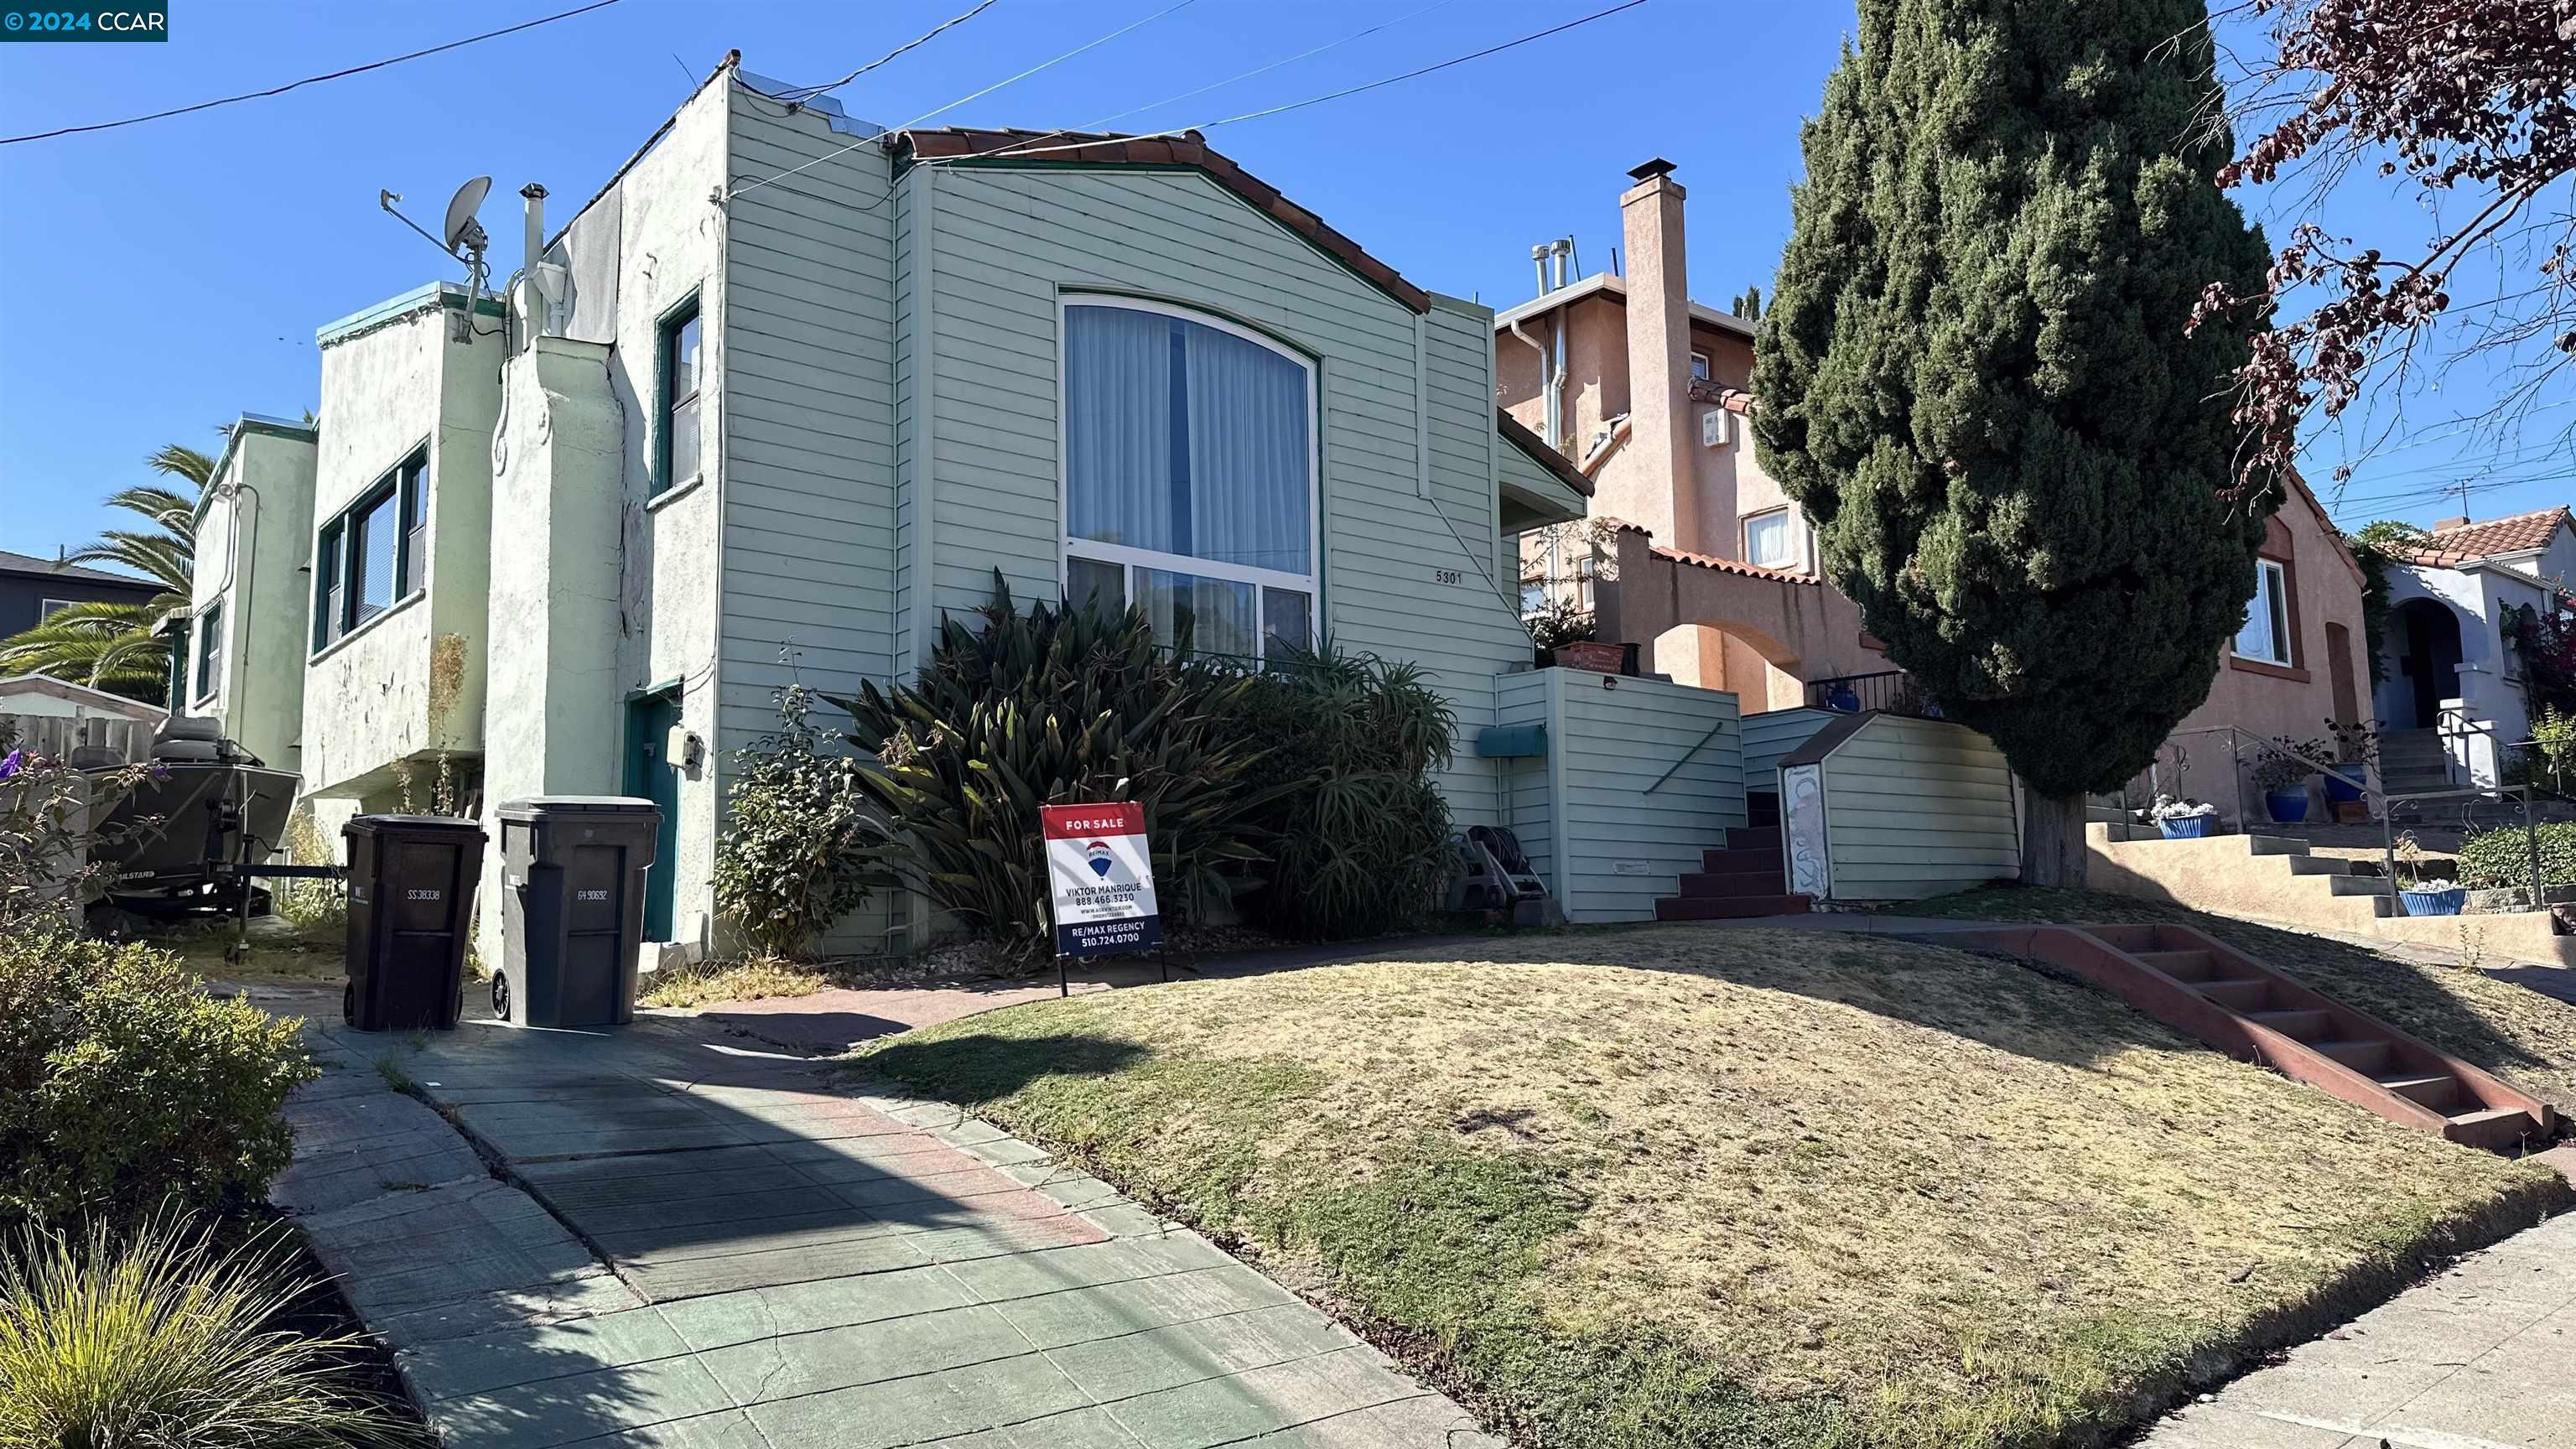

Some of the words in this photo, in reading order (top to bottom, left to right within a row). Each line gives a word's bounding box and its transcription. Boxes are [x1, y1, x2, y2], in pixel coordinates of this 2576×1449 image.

[1436, 570, 1462, 584] 5301
[1066, 820, 1090, 831] FOR
[1093, 818, 1124, 828] SALE
[1066, 886, 1097, 897] VIKTOR
[1098, 882, 1141, 895] MANRIQUE
[1075, 892, 1135, 906] 888.466.3230
[1072, 925, 1106, 937] RE/MAX
[1106, 921, 1145, 933] REGENCY
[1082, 932, 1140, 948] 510.724.0700
